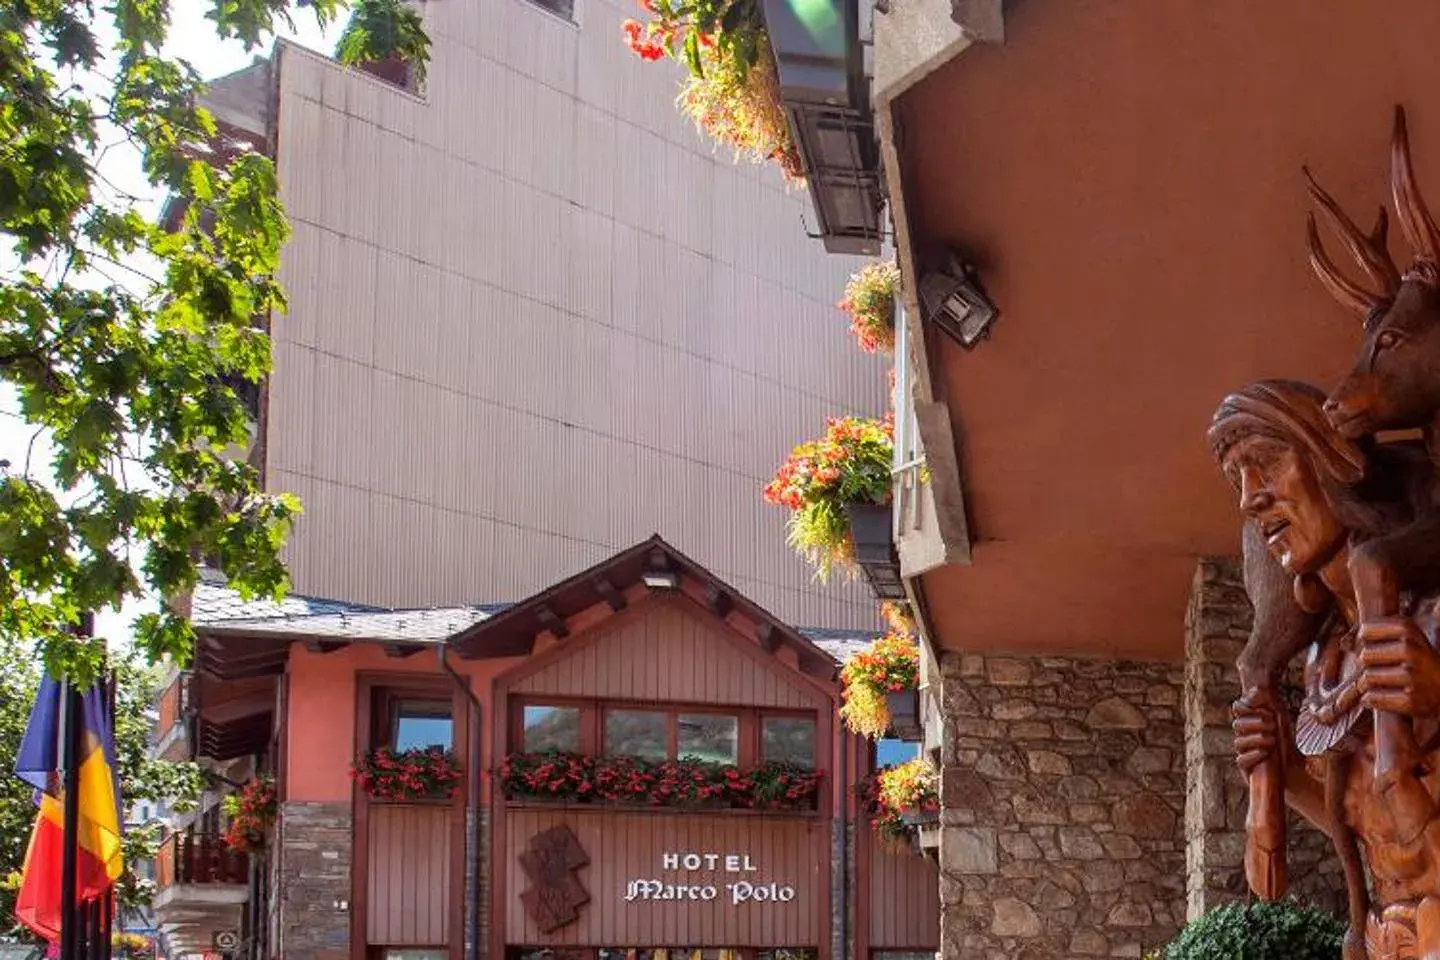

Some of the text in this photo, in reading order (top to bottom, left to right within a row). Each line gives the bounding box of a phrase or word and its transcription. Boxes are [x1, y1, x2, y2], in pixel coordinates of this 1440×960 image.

[663, 853, 757, 872] HOTEL
[624, 878, 795, 905] Marco Polo
